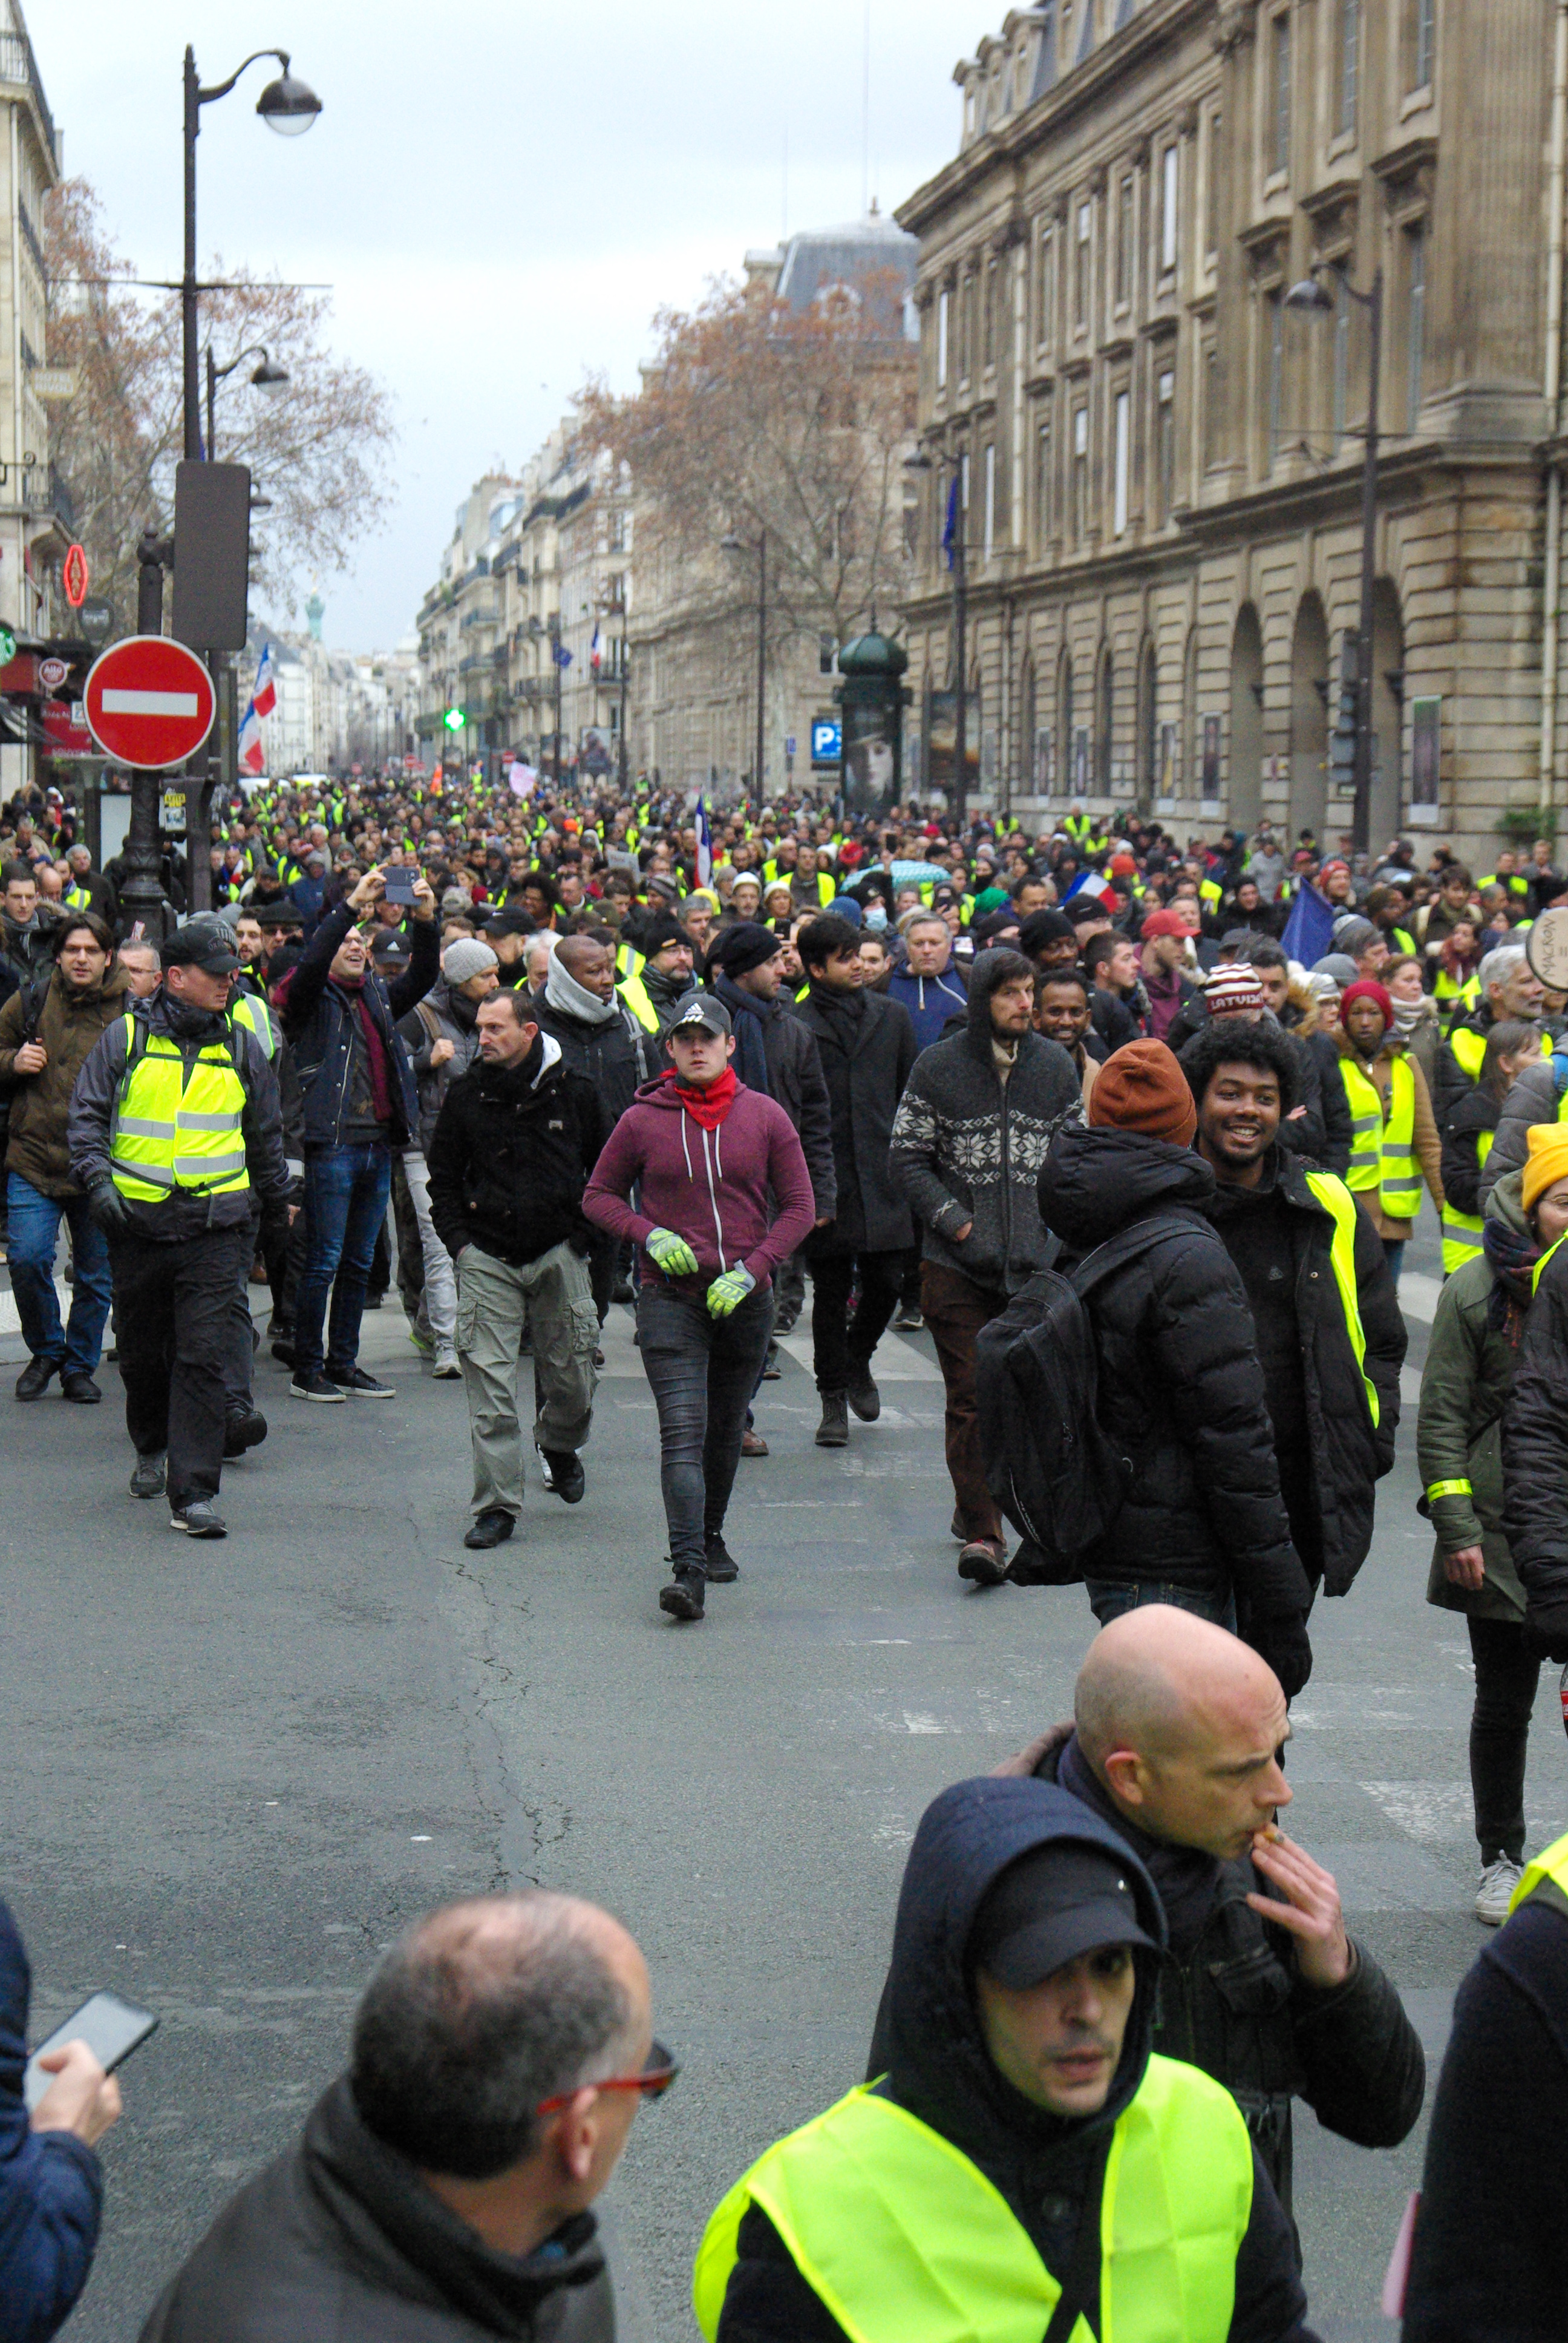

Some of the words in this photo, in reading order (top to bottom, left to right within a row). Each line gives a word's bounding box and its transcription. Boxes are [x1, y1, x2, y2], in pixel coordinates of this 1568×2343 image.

[35, 371, 71, 382] HOTEL
[35, 381, 73, 393] RIVOLI
[815, 726, 835, 752] P
[1543, 917, 1556, 977] MACRON
[713, 1282, 743, 1303] FOX
